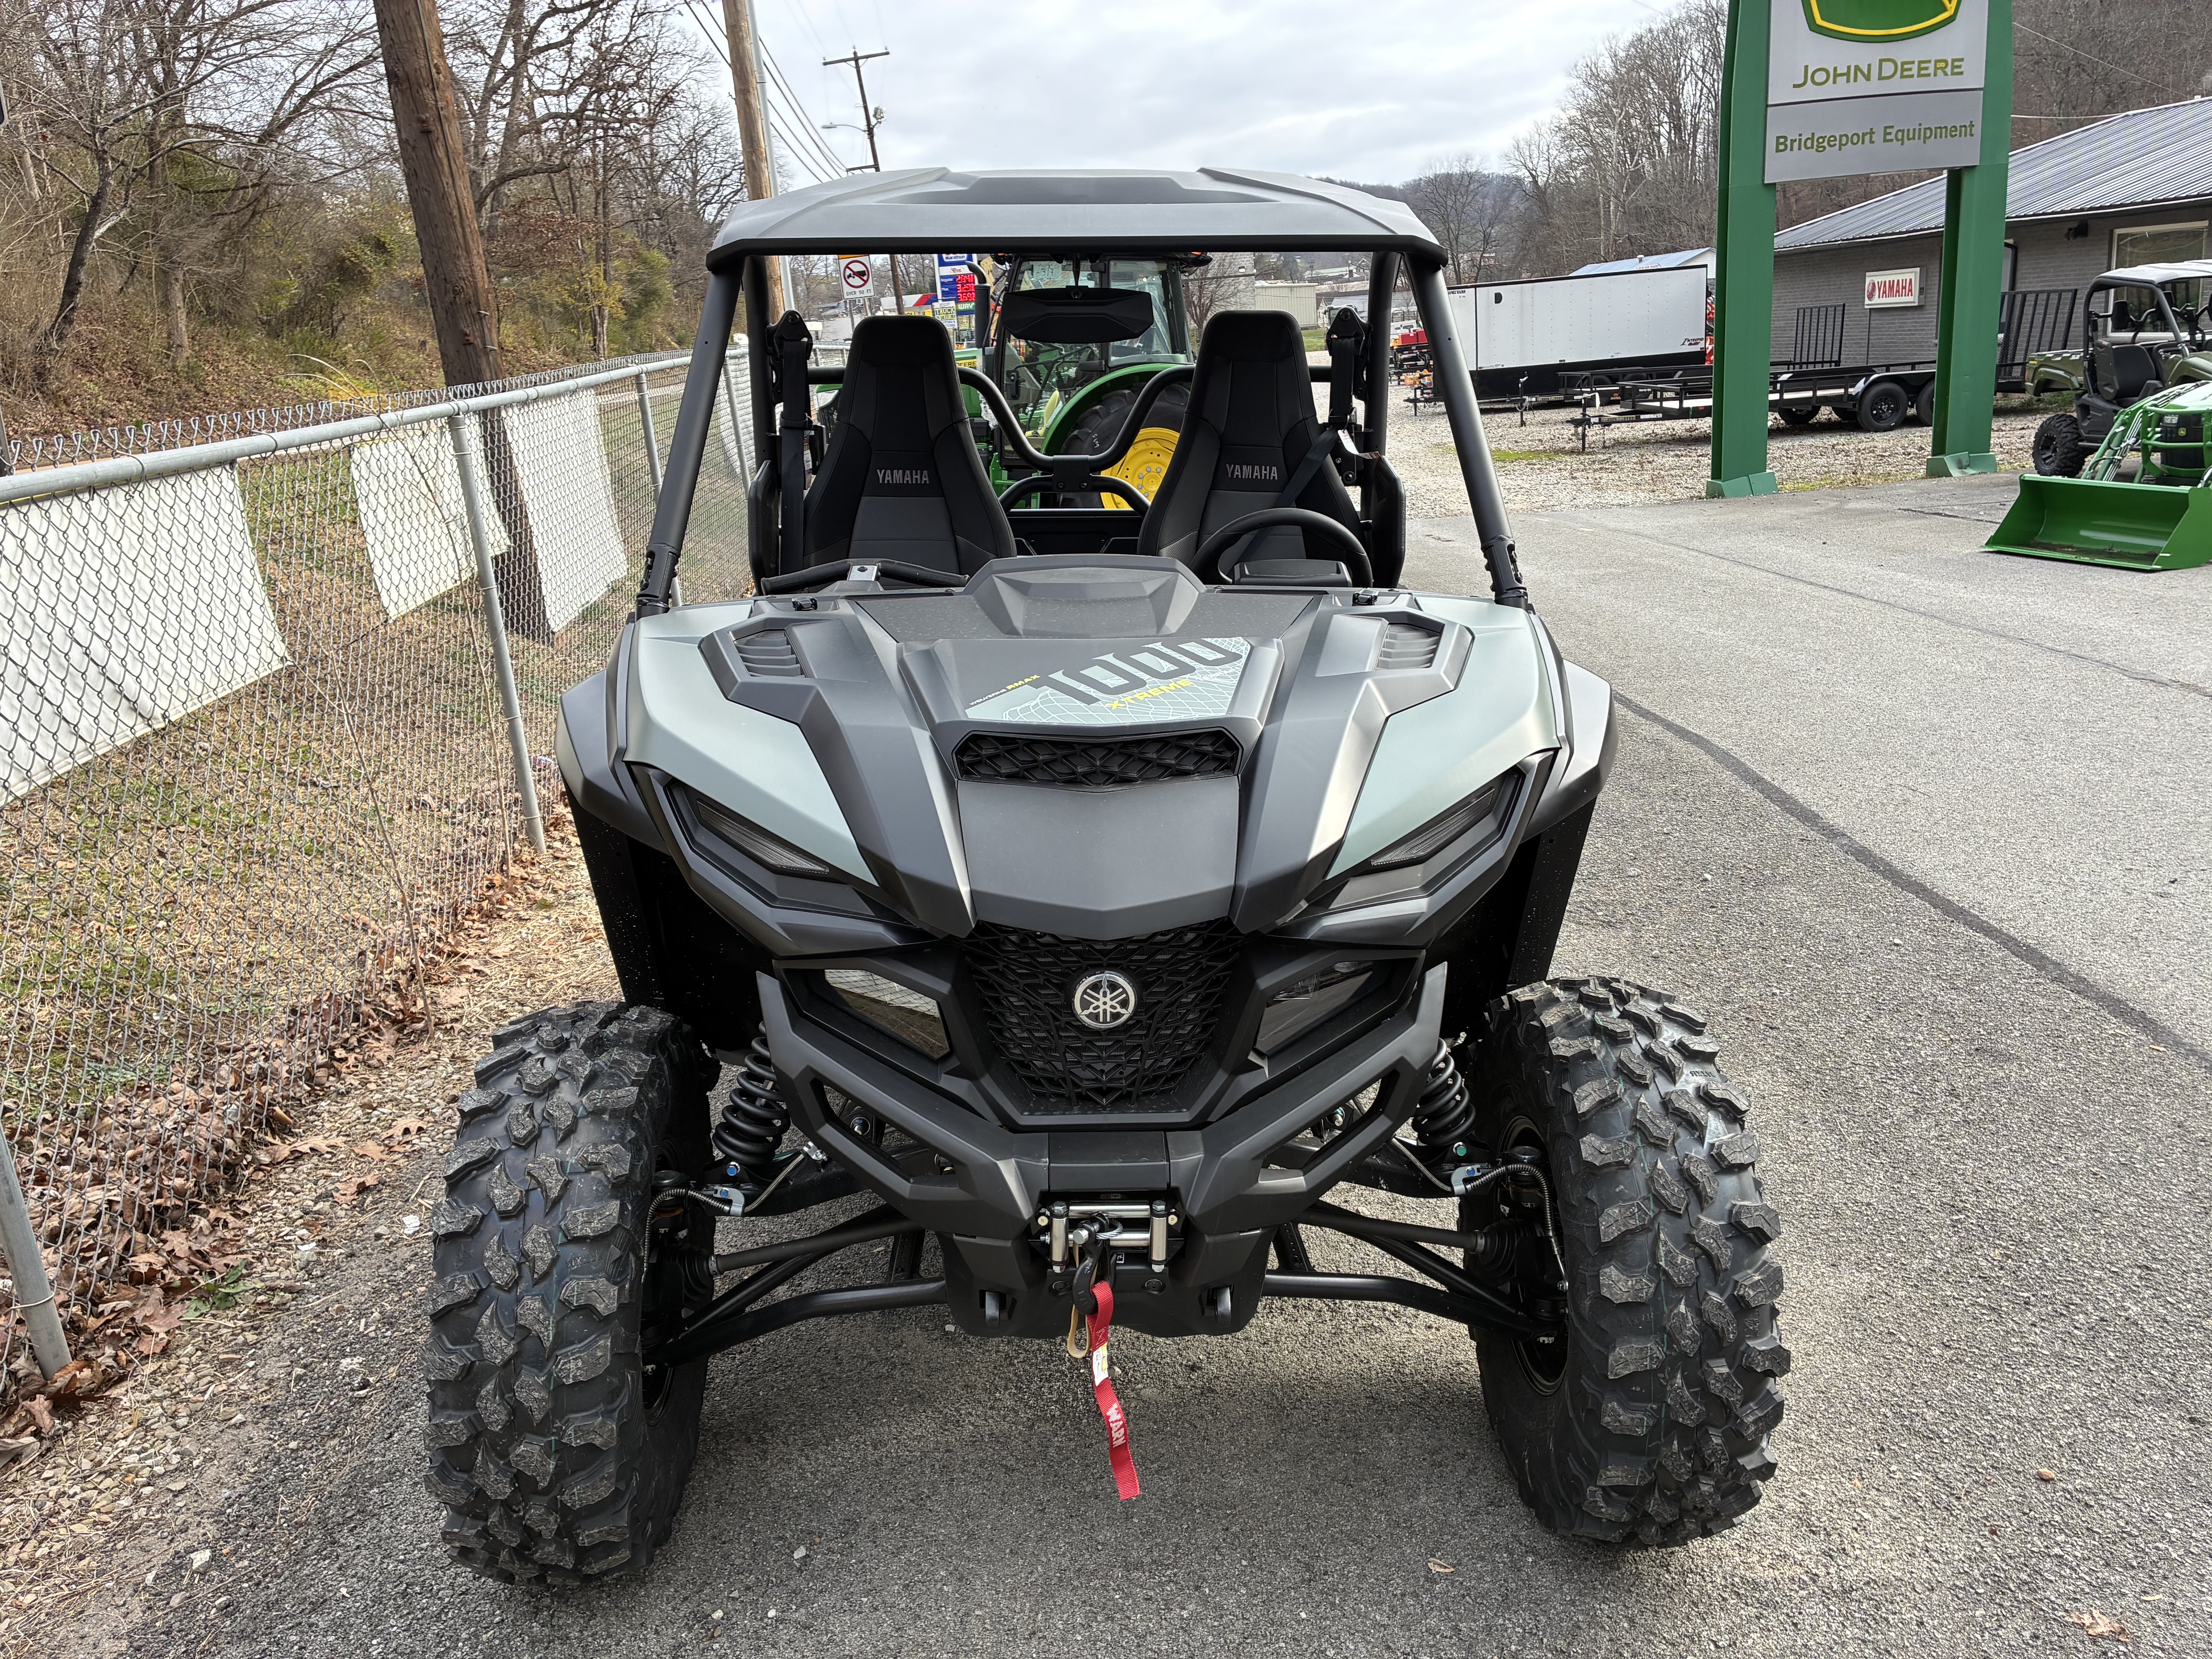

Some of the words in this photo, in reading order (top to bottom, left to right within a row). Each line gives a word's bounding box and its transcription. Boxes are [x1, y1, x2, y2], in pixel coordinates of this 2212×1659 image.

[1793, 62, 1871, 88] JOHN
[1878, 57, 1965, 81] DEERE
[1775, 127, 1875, 154] Bridgeport
[1882, 120, 1975, 146] Equipment
[1877, 278, 1913, 299] YAMAHA
[876, 469, 929, 484] YAMAHA
[1226, 464, 1278, 480] YAMAHA
[1031, 639, 1243, 706] 1000
[969, 689, 1007, 705] WOLVERINE
[1105, 679, 1194, 710] XTREME
[1106, 1403, 1126, 1448] WARN
